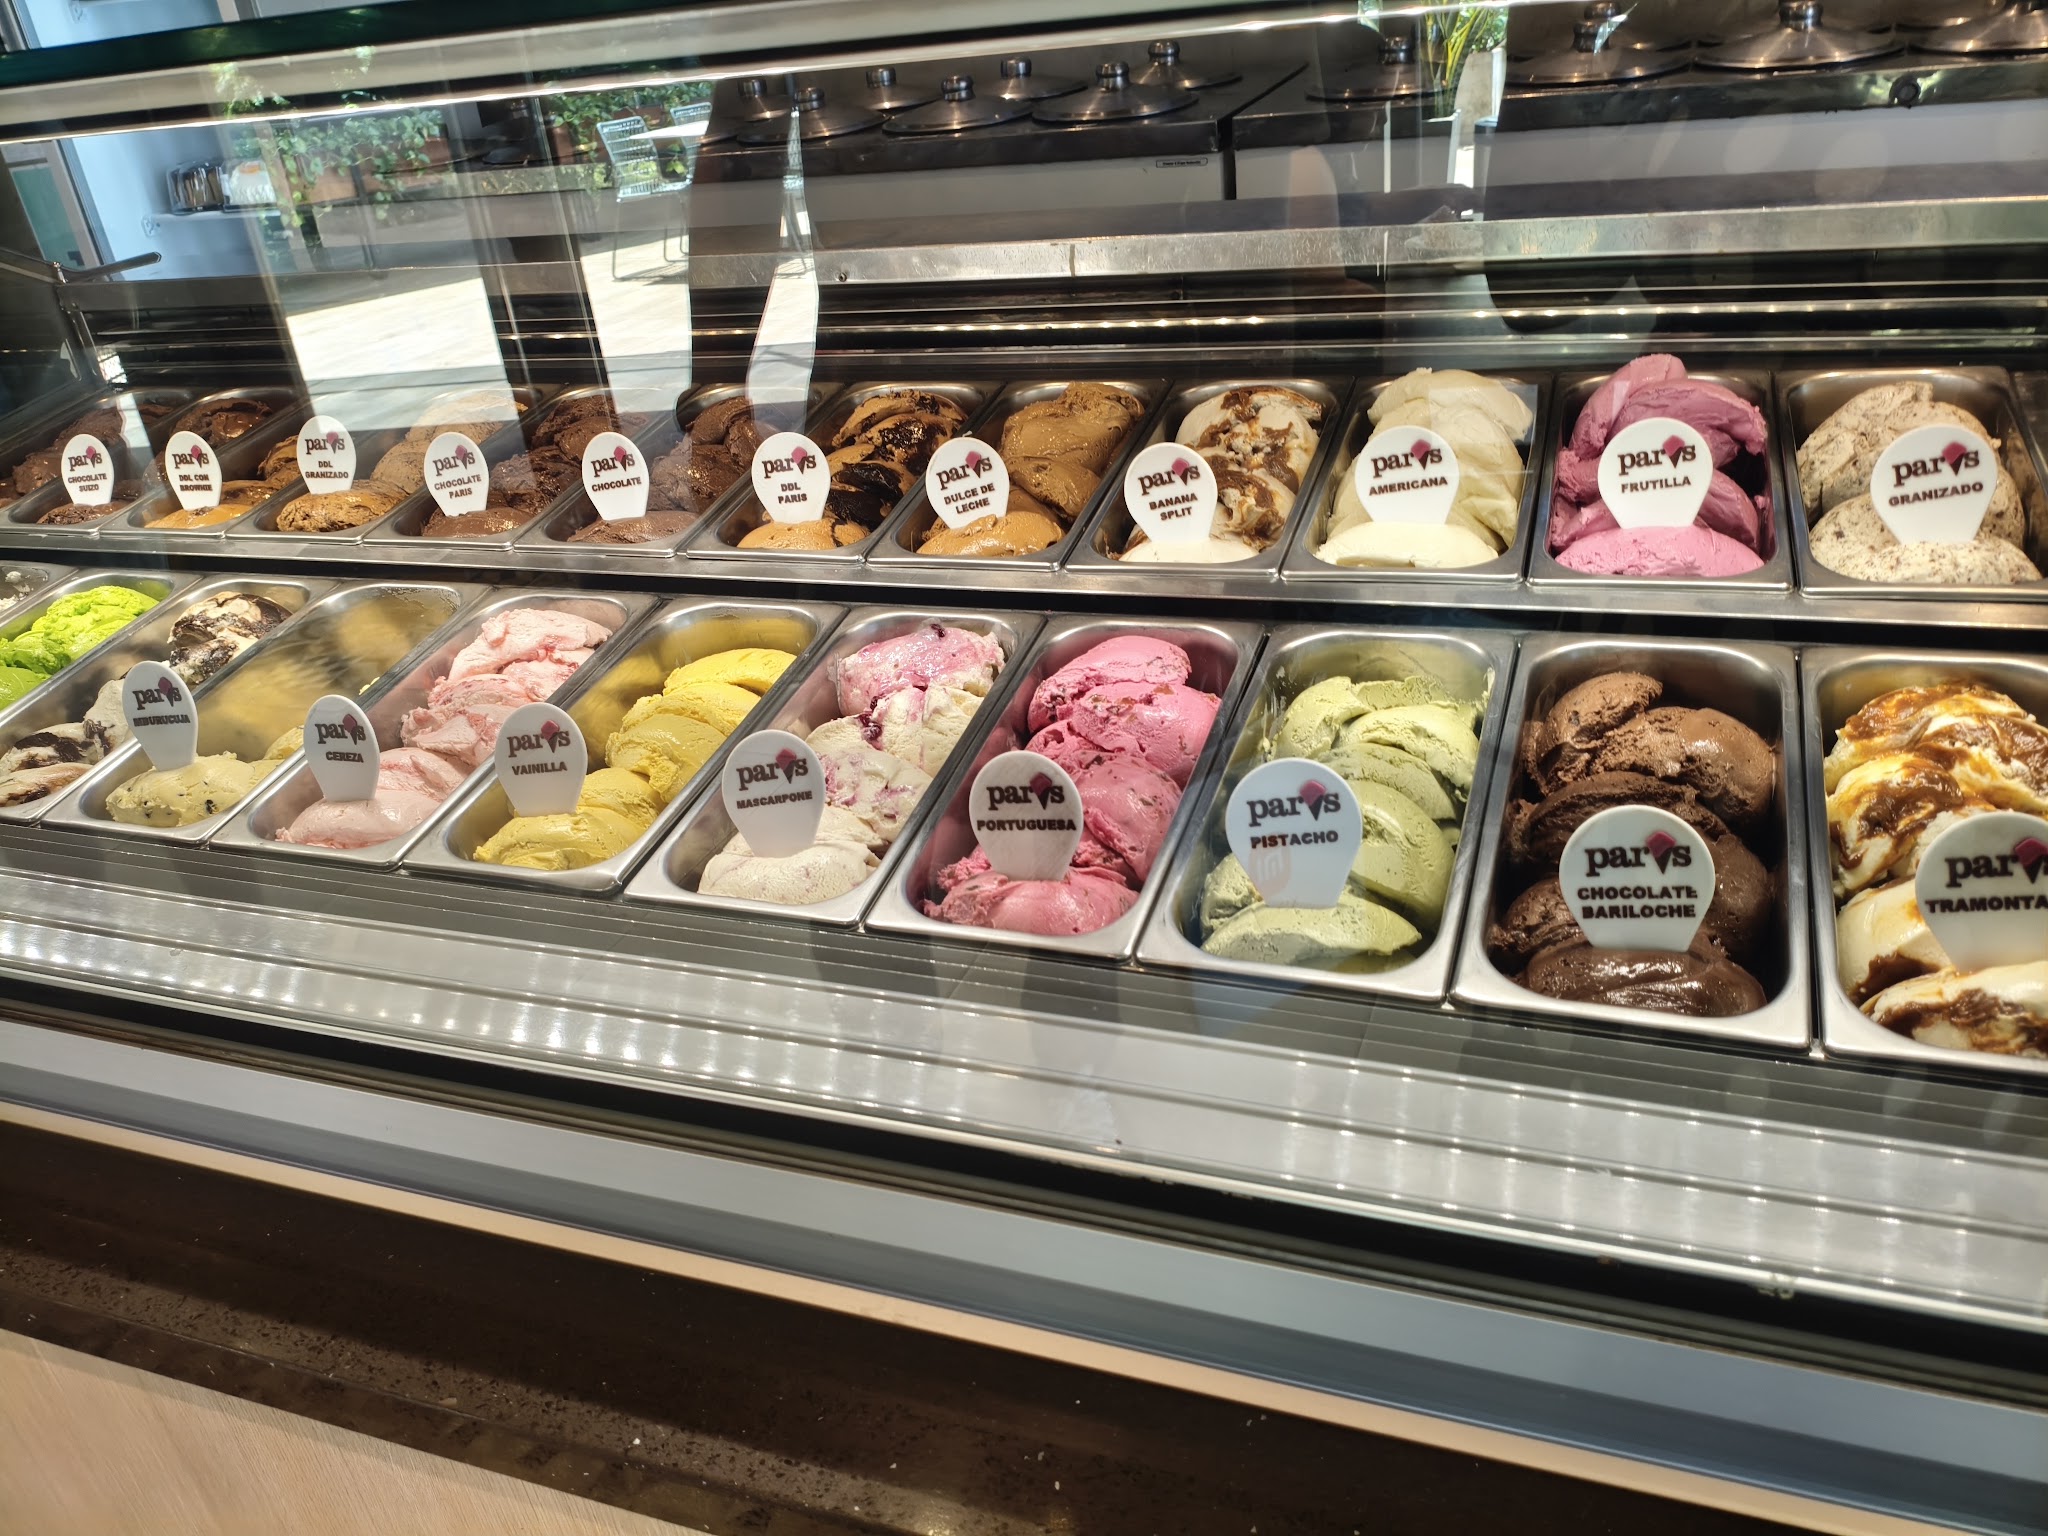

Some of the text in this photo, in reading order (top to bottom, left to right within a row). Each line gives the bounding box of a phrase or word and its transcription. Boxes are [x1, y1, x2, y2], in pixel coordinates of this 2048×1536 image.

[318, 460, 333, 468] DDL
[67, 473, 107, 484] CHOCOLATE
[305, 471, 349, 479] GRANIZADO
[434, 474, 482, 490] CHOCOLATE
[180, 484, 213, 492] BROWNIE
[591, 476, 642, 492] CHOCOLATE
[780, 482, 801, 492] DDL
[1368, 476, 1448, 496] AMERICANA
[1621, 476, 1692, 494] FRUTILLA
[449, 488, 472, 499] PARIS
[778, 493, 808, 504] PARIS
[944, 482, 996, 506] DULCE DE
[1148, 492, 1198, 511] BANANA
[1888, 482, 1984, 507] GRANIZADO
[955, 498, 990, 515] LECHE
[1160, 506, 1192, 522] SPLIT
[326, 752, 364, 763] CEREZA
[512, 760, 568, 776] VAINILLA
[736, 790, 813, 810] MASCARPONE
[976, 818, 1076, 832] PORTUGUESA
[1250, 830, 1338, 849] PISTACHO
[1577, 886, 1698, 901] CHOCOLATE
[1582, 904, 1696, 920] BARILOCHE
